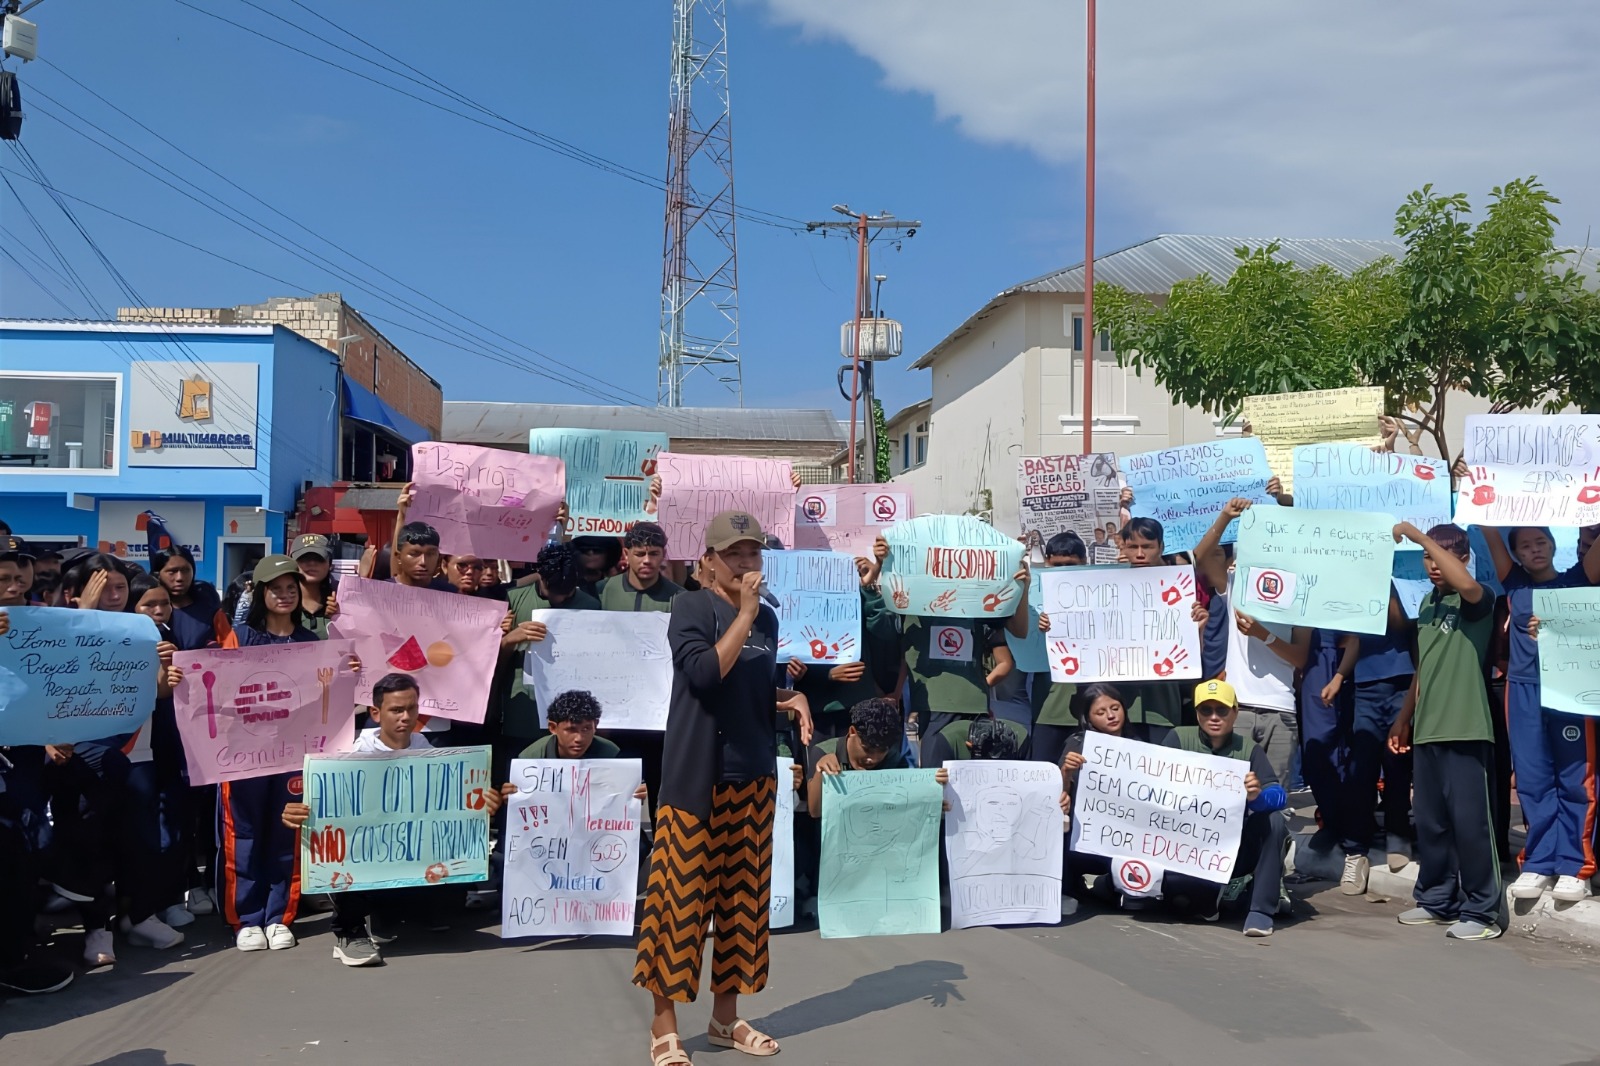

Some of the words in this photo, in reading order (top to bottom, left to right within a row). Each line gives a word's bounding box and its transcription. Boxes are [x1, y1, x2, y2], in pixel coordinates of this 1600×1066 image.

[1158, 444, 1223, 466] ESTAMOS
[1298, 445, 1341, 478] SEM
[1126, 460, 1208, 486] ESTUDANDO
[1025, 480, 1086, 496] DESCASO!
[578, 517, 621, 533] ESTADO
[1313, 526, 1321, 538] A
[1058, 582, 1119, 609] COMIDA
[1131, 582, 1153, 611] NA
[217, 741, 293, 767] Comida
[1091, 746, 1132, 771] SEM
[382, 765, 414, 813] COM
[519, 766, 564, 794] SEM
[1086, 771, 1122, 797] SEM
[1213, 807, 1227, 824] A
[1083, 797, 1135, 821] NOSSA
[1149, 812, 1220, 846] REVOLTA
[530, 837, 568, 860] SEM
[1101, 824, 1134, 850] POR
[1142, 833, 1232, 873] EDUCAÇÃO
[508, 897, 545, 930] AOS
